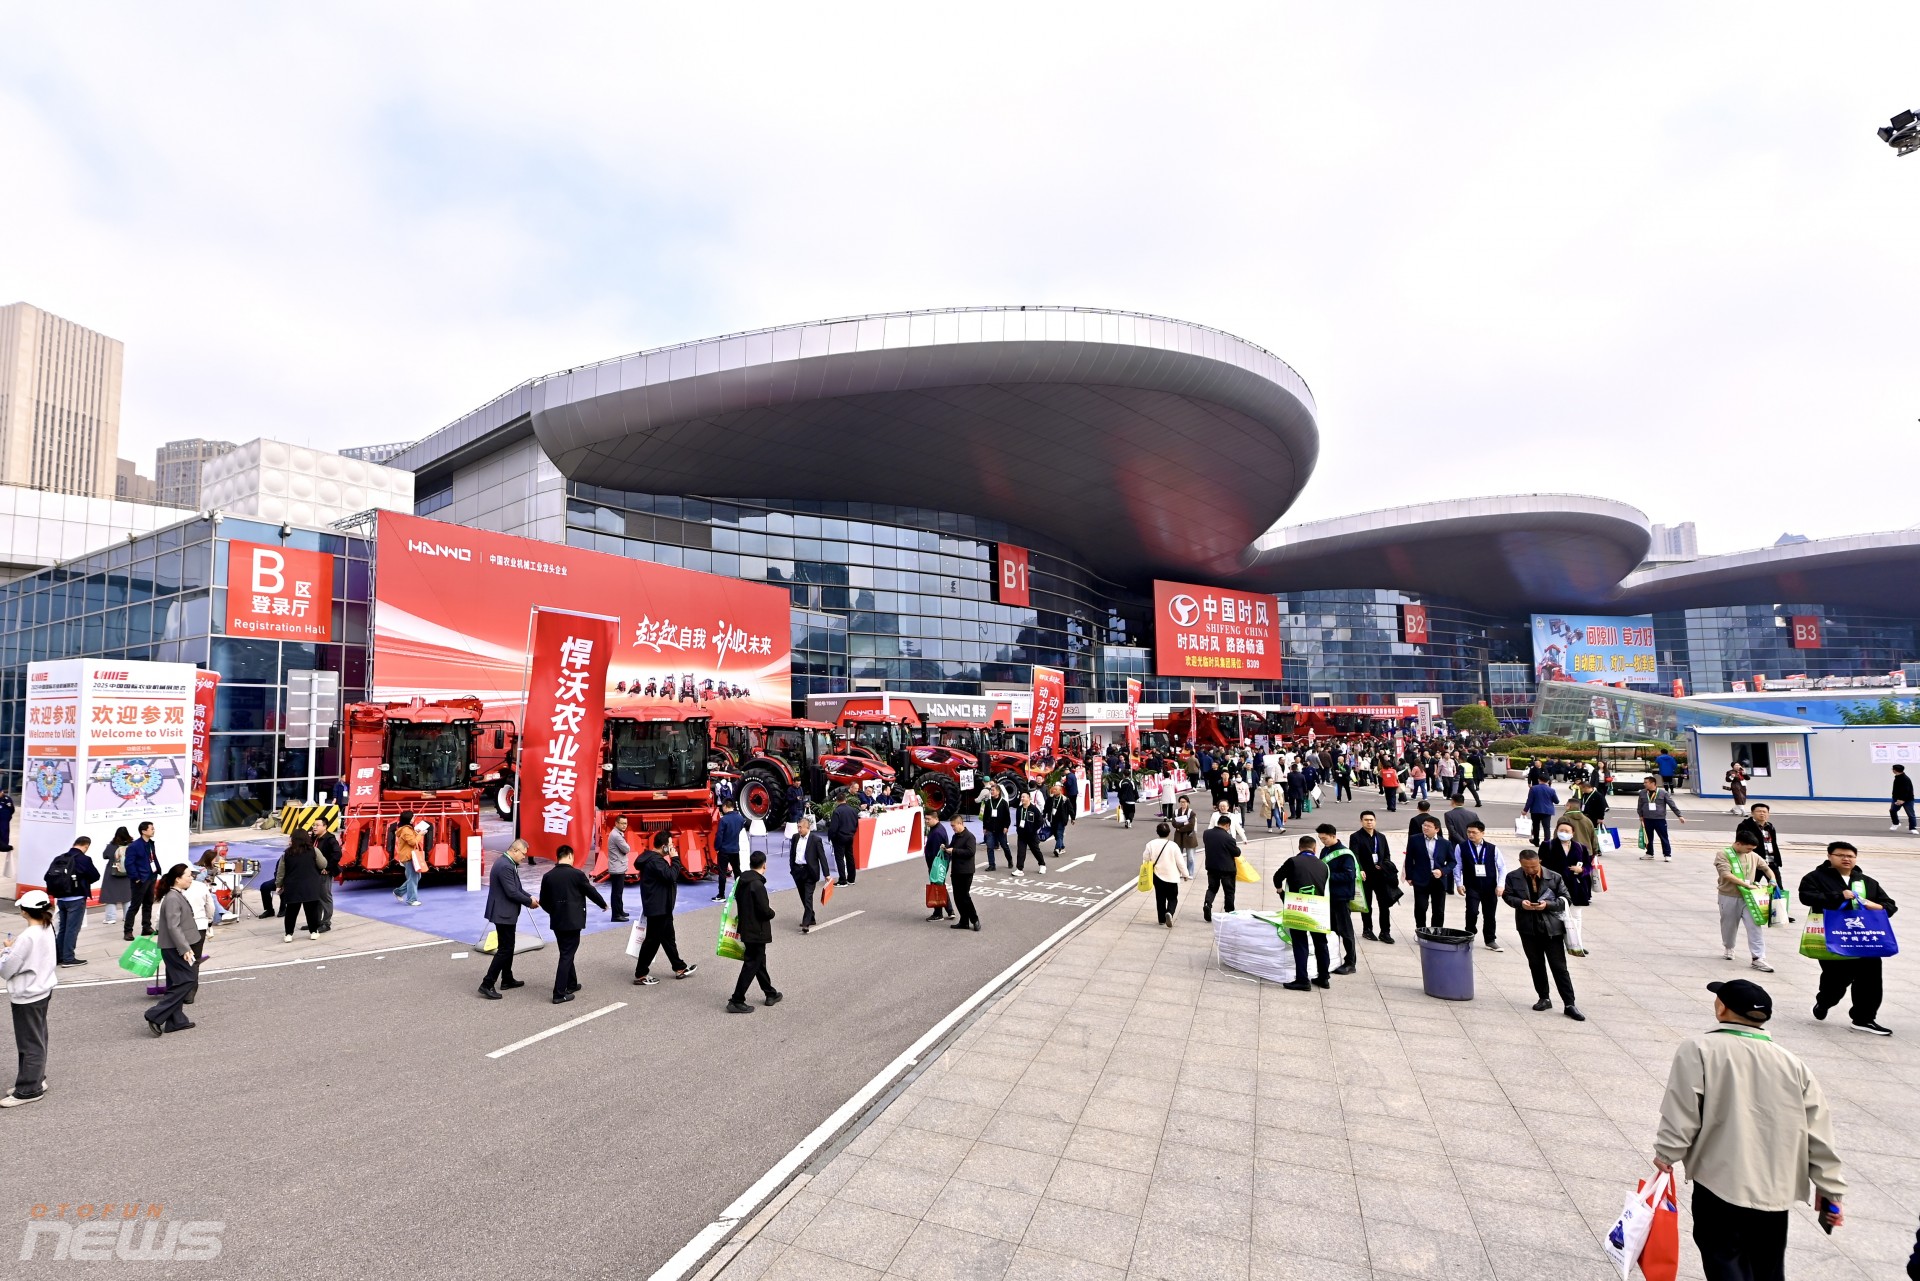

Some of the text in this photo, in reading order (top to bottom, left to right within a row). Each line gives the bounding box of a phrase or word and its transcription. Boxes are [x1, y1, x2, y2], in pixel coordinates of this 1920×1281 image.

[252, 548, 312, 598] B 区
[489, 554, 568, 576] 中国农业机械工业龙头企业
[1003, 559, 1025, 591] B1
[251, 595, 309, 617] 登录厅
[1203, 594, 1269, 626] 中国时风
[234, 618, 325, 634] Registration Hall
[1205, 623, 1269, 637] SHIFENG CHINA
[1406, 614, 1425, 634] B2
[1795, 624, 1817, 641] B3
[1177, 633, 1264, 655] 时风时风 路路畅通
[1586, 625, 1654, 647] 间隙小 草才好
[30, 705, 76, 725] 欢迎参观
[91, 705, 184, 725] 欢迎参观
[1033, 686, 1049, 737] 动力换挡
[1042, 696, 1060, 747] 动力换向
[1063, 706, 1080, 715] ISA
[29, 729, 75, 738] Welcome to Visit
[91, 728, 184, 738] Welcome to Visit
[541, 635, 594, 836] 悍沃农业装备
[355, 767, 375, 796] 悍沃
